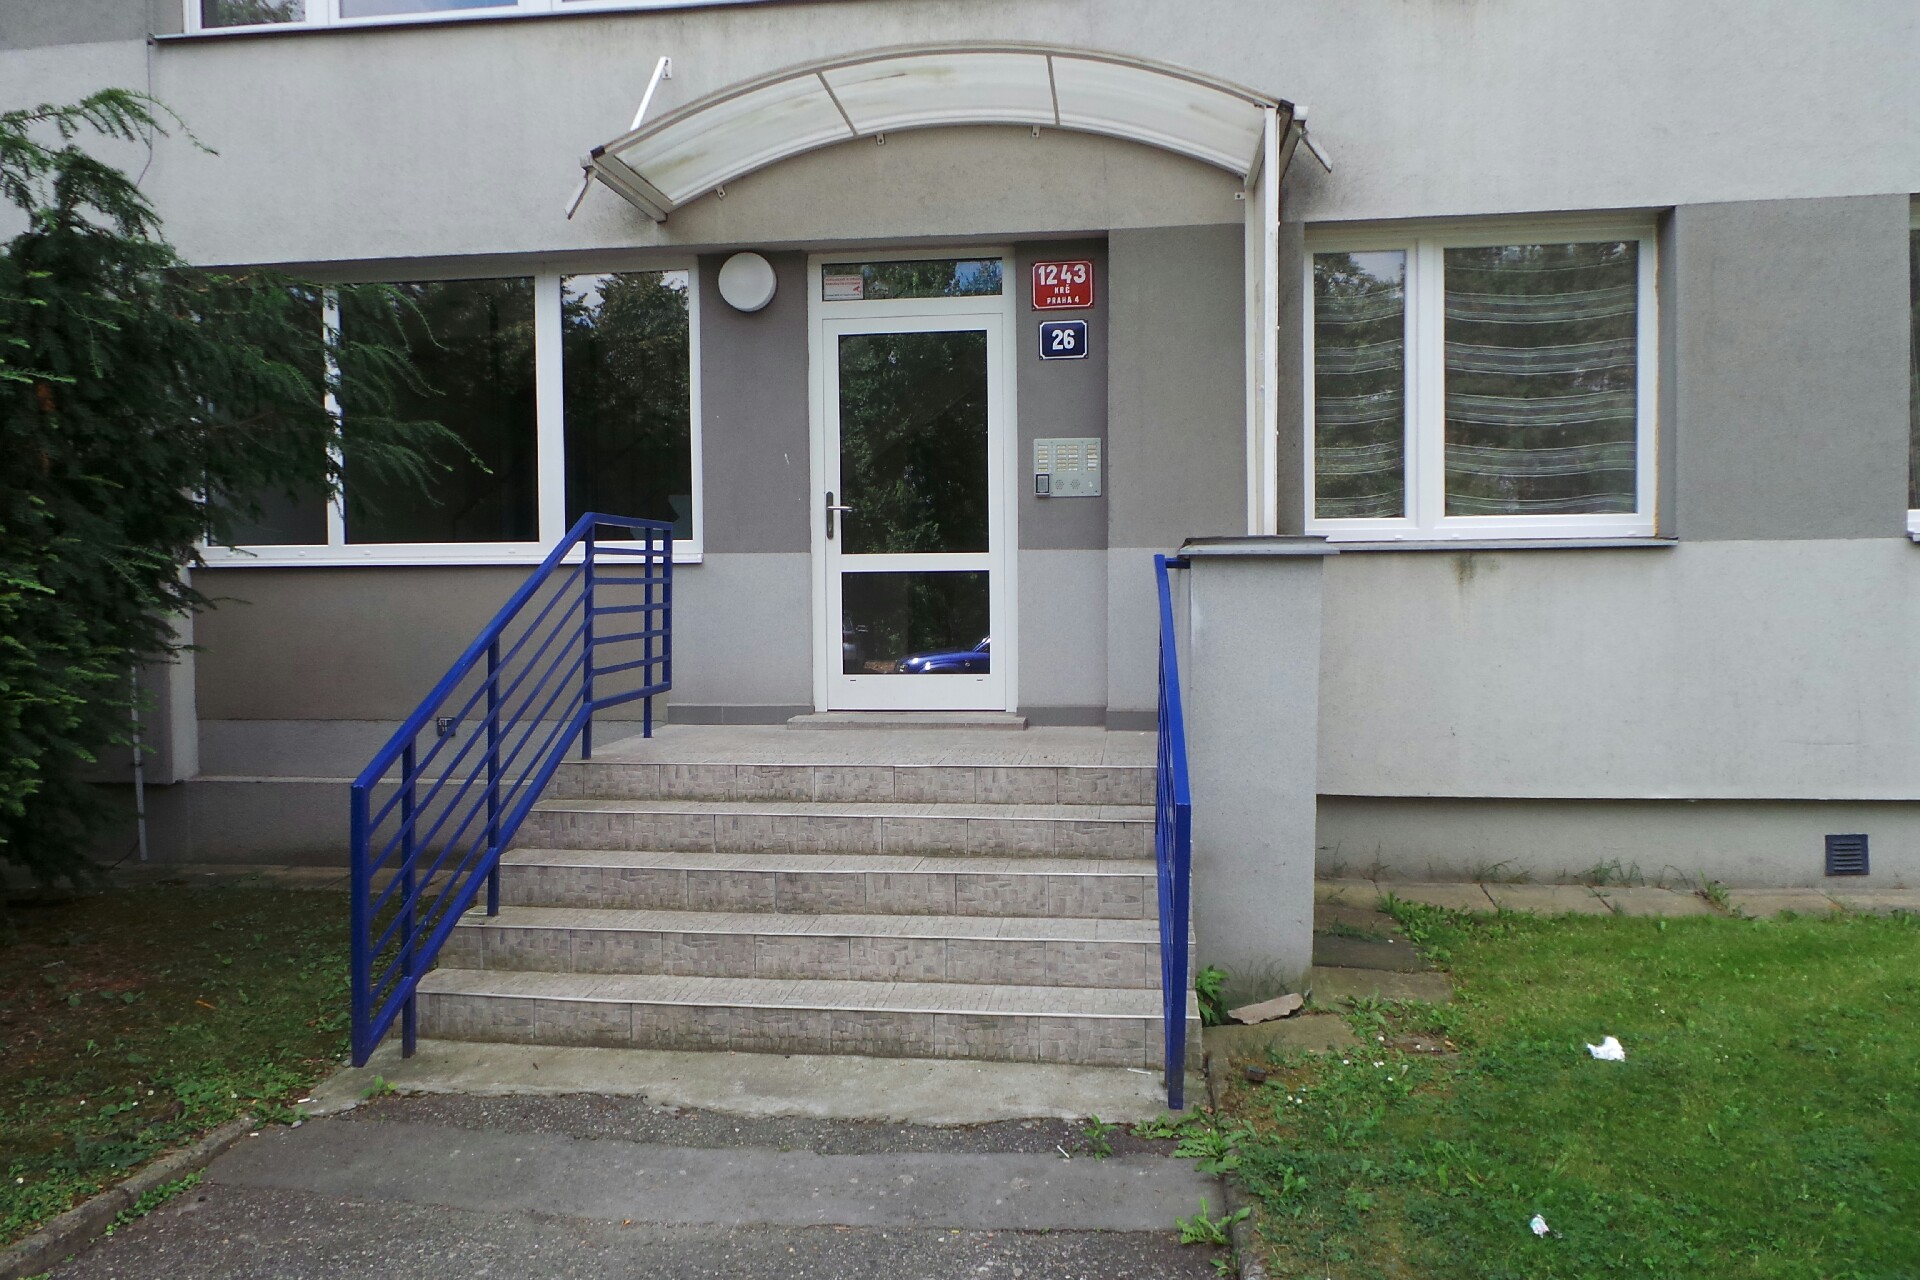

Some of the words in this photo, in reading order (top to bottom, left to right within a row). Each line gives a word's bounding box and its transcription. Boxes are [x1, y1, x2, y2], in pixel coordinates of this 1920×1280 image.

[1038, 264, 1086, 285] 1243
[1054, 284, 1070, 294] KRČ
[1046, 296, 1072, 304] PRAHA
[1074, 295, 1080, 303] 4
[1051, 329, 1075, 350] 26
